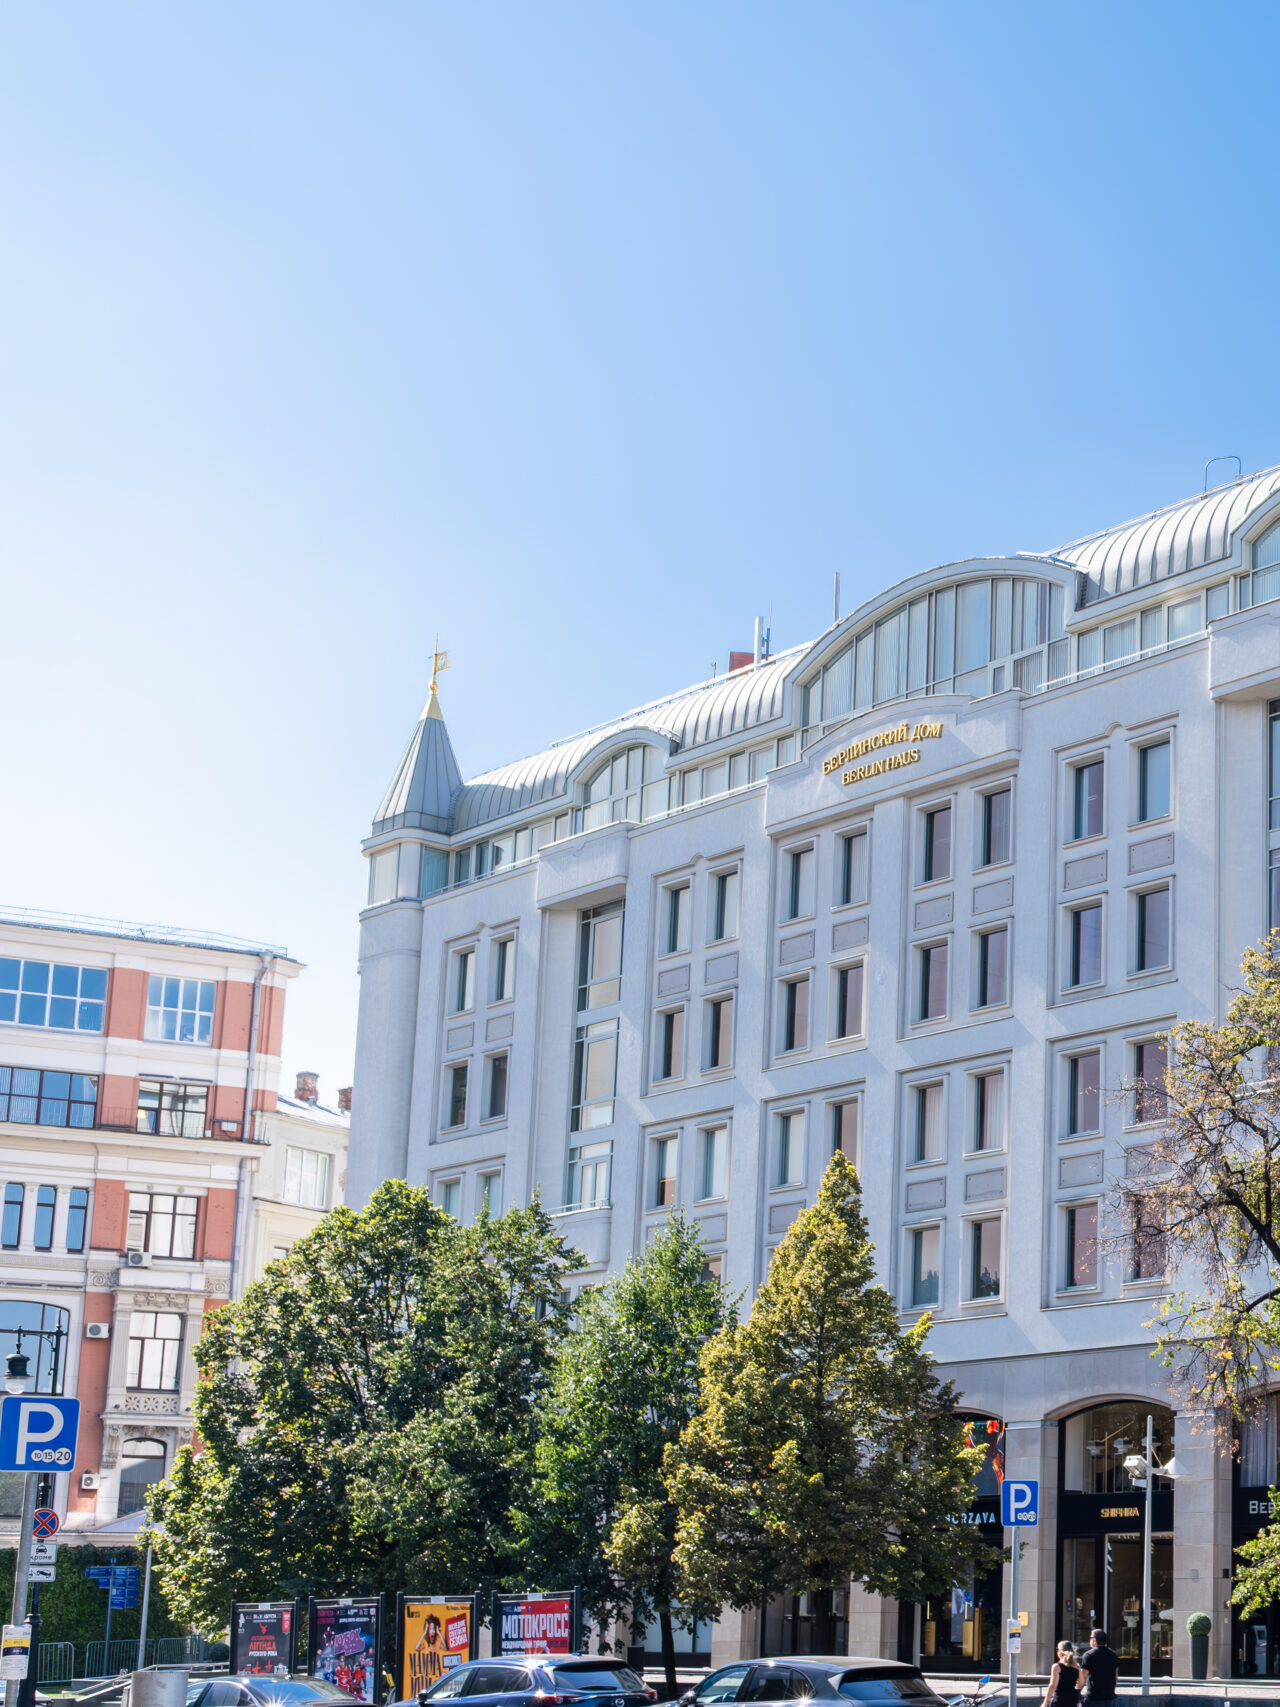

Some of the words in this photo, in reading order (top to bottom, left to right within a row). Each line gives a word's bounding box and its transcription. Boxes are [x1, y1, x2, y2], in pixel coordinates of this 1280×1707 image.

[822, 723, 909, 776] БЕРЛИНСКИЙ
[911, 723, 943, 743] ДОМ
[842, 760, 886, 786] BERLIN
[886, 748, 921, 771] HAUS
[16, 1402, 65, 1465] P
[44, 1451, 53, 1460] 15
[56, 1450, 71, 1461] 20
[1010, 1483, 1032, 1523] P
[1100, 1507, 1140, 1518] SHIPHRA
[502, 1613, 568, 1639] МОТОКРОСС
[249, 1641, 277, 1651] ЛЕГЕНДА
